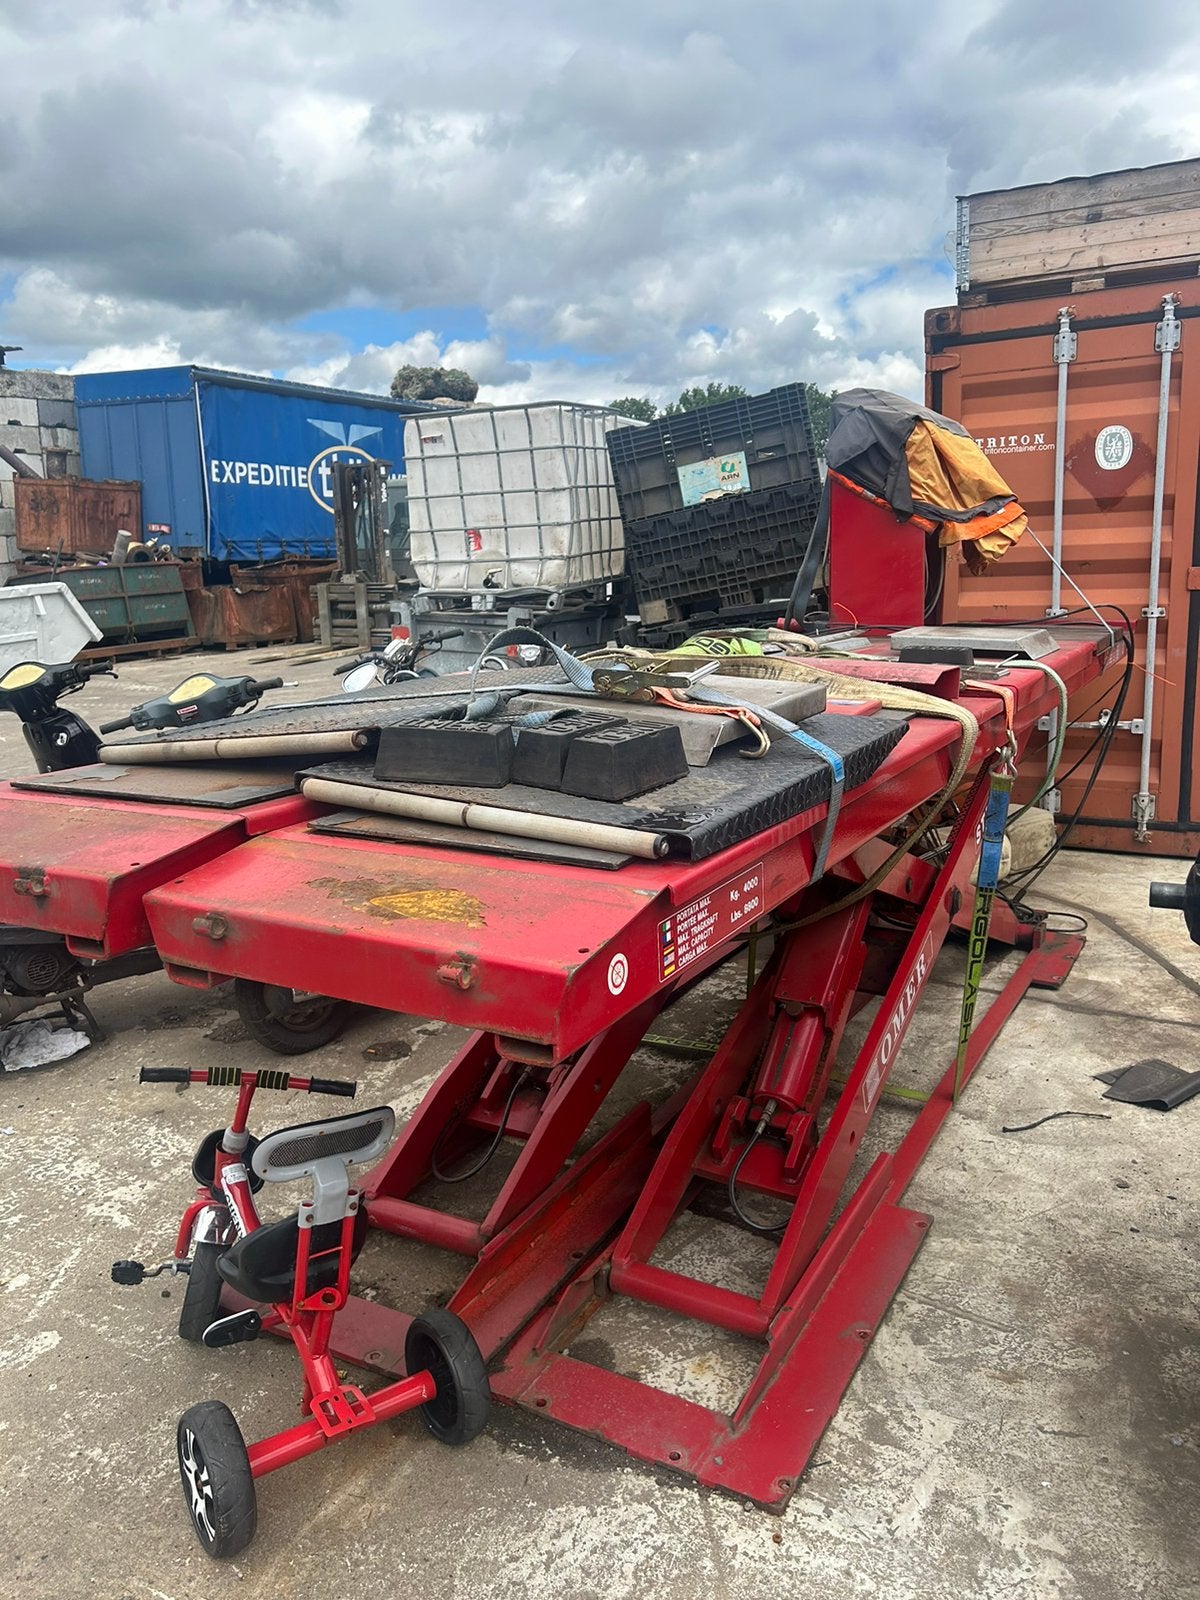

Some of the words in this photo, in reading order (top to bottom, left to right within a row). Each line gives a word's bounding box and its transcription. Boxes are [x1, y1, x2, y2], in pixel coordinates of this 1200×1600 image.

[975, 433, 1045, 448] TRITON
[211, 460, 308, 488] EXPEDITIE
[743, 876, 759, 893] 4000
[676, 903, 699, 923] PORTATA
[691, 926, 715, 947] CAPACITY
[678, 949, 696, 967] CARGA
[881, 953, 927, 1066] OMER
